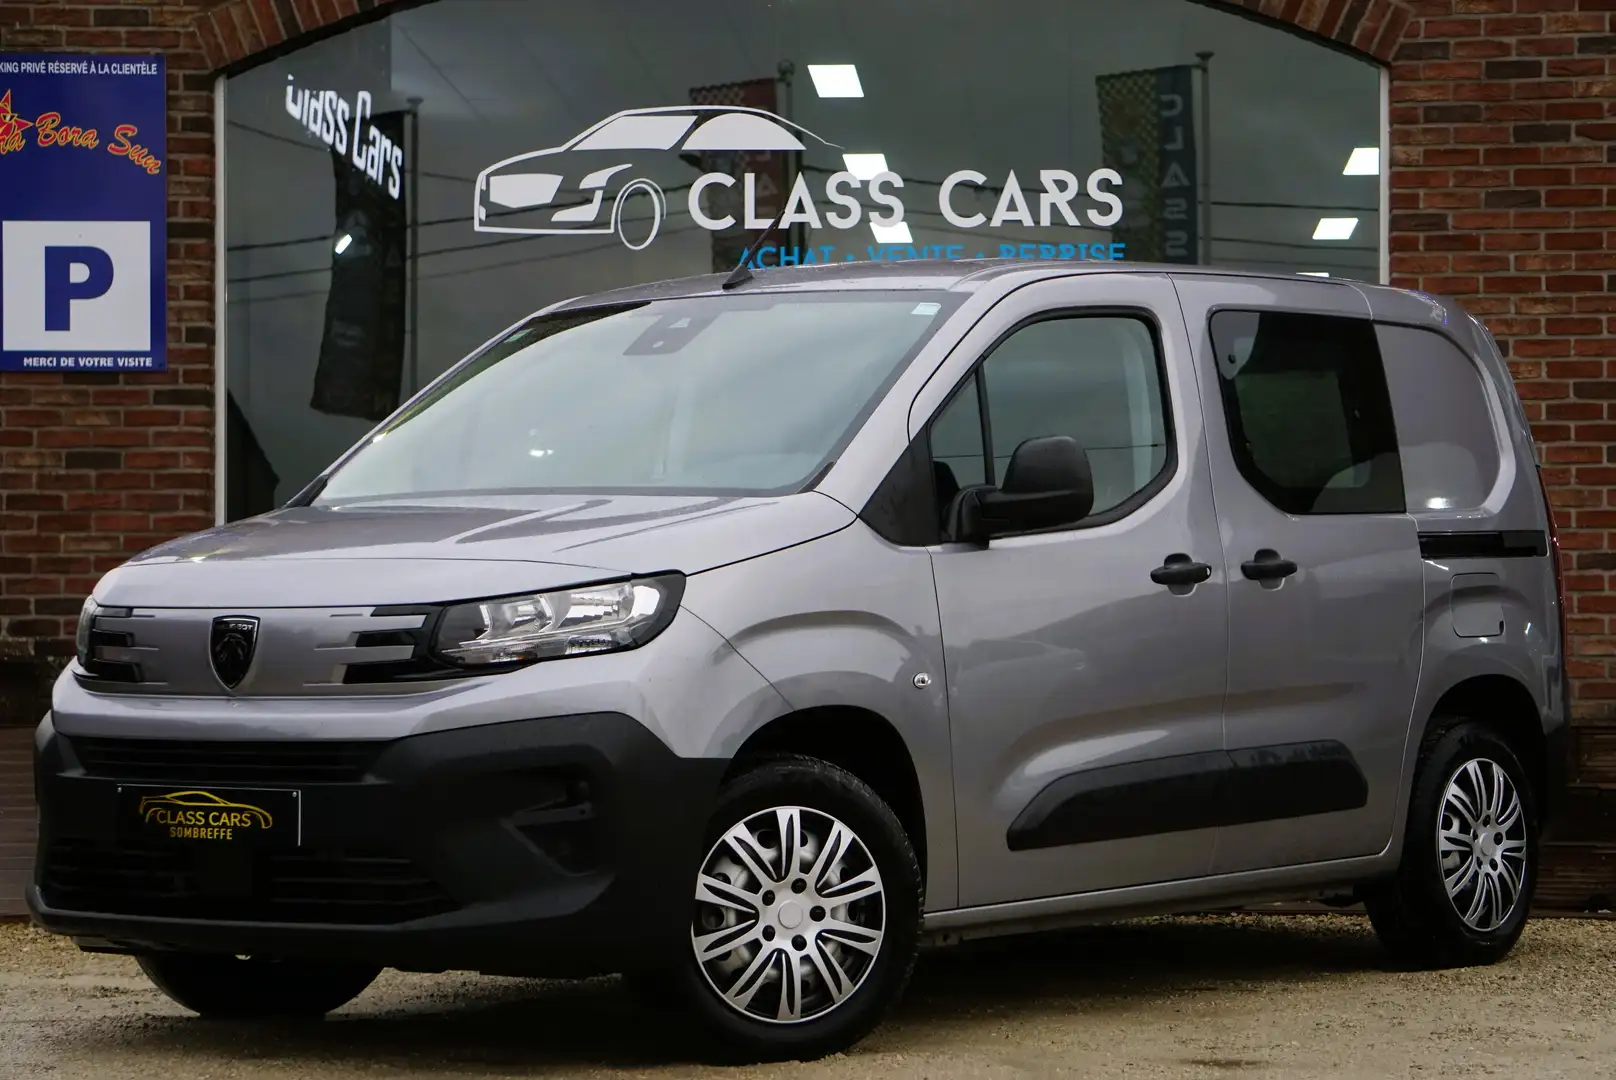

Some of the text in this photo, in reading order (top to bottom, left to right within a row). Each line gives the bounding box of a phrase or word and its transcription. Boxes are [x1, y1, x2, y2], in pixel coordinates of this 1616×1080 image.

[21, 60, 46, 73] PRIVÉ
[48, 60, 88, 74] RÉSERVÉ
[90, 60, 97, 74] À
[99, 63, 110, 74] LA
[111, 61, 158, 75] CLIENTÈLE
[35, 111, 100, 149] Bora
[107, 124, 162, 174] Sun
[352, 90, 403, 200] Cars
[688, 170, 905, 231] CLASS
[938, 168, 1124, 228] CARS
[44, 245, 115, 332] P
[23, 356, 153, 367] MERCI DE VOTRE VISITE
[156, 810, 251, 827] CLASS CARS
[170, 826, 233, 840] SOMBREFFE
